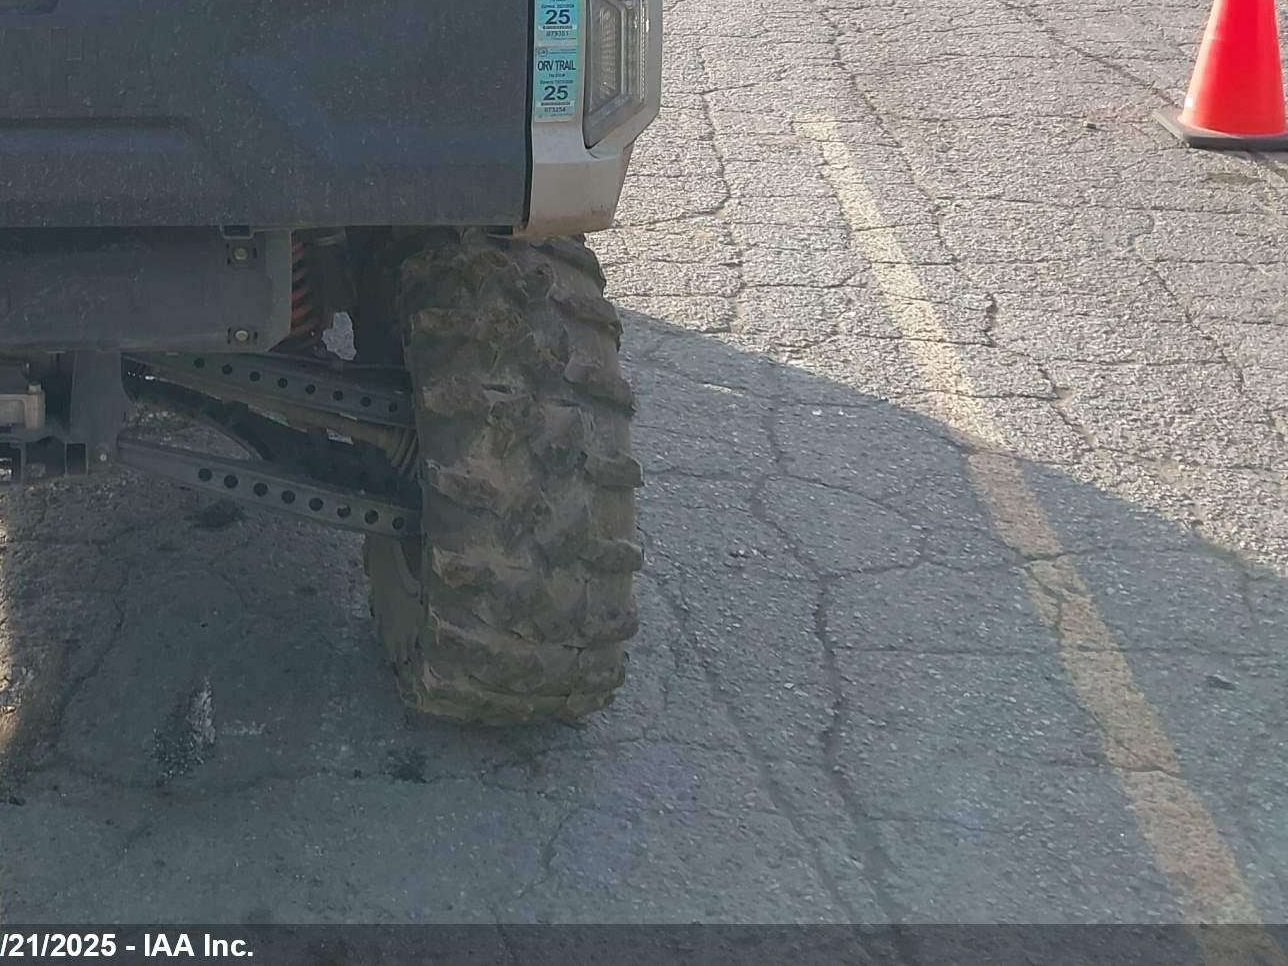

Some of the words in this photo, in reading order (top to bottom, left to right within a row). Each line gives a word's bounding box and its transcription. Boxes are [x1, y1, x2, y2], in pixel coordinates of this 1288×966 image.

[545, 9, 571, 25] 25
[537, 60, 553, 71] ORV
[555, 59, 577, 71] TRAIL
[543, 85, 569, 101] 25
